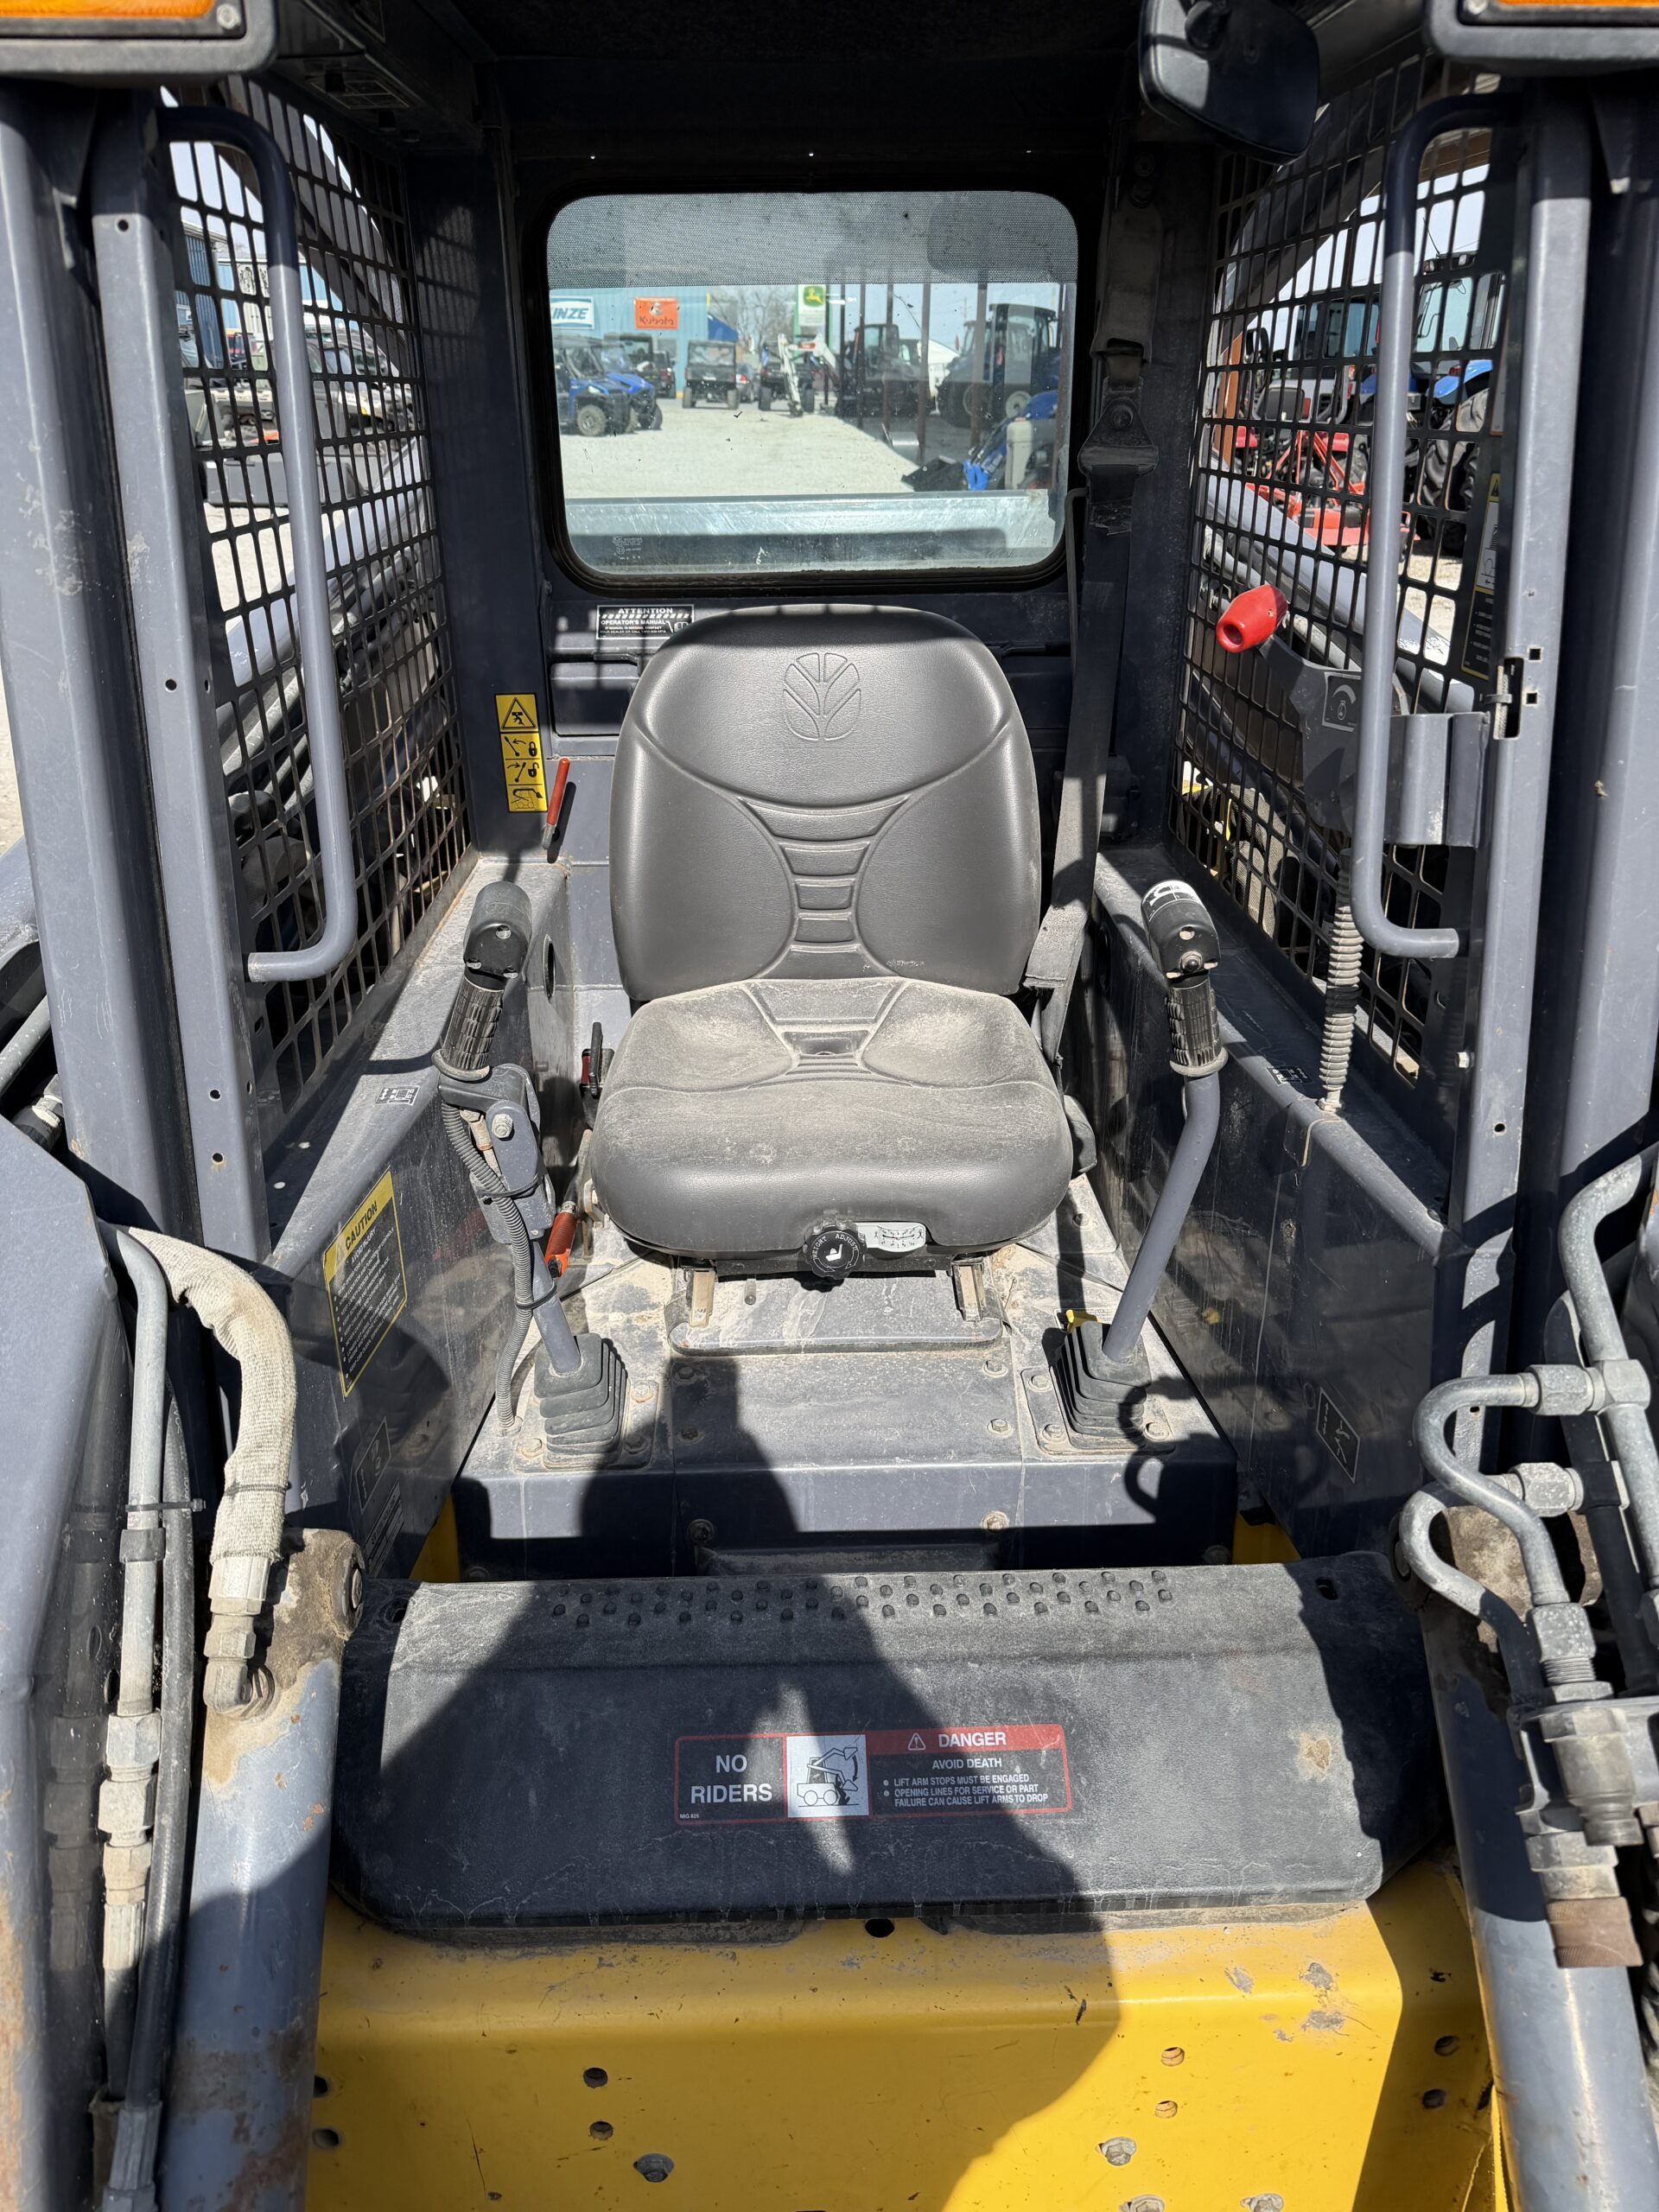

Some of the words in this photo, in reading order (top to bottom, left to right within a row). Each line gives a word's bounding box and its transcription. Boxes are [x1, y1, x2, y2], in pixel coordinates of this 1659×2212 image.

[639, 315, 674, 326] Kubota
[346, 1200, 378, 1250] CAUTION
[812, 1236, 827, 1259] WEIGHT
[835, 1234, 859, 1250] ADJUST
[938, 1732, 1007, 1748] DANGER
[715, 1754, 747, 1773] NO
[932, 1758, 964, 1770] AVOID
[966, 1758, 1002, 1768] DEATH
[893, 1777, 910, 1787] LIFT
[912, 1777, 929, 1786] ARM
[930, 1777, 956, 1785] STOPS
[957, 1776, 978, 1784] MUST
[980, 1775, 990, 1783] BE
[992, 1773, 1029, 1783] ENGAGED
[690, 1783, 772, 1804] RIDERS
[894, 1788, 929, 1797] OPENING
[931, 1787, 953, 1796] LINES
[955, 1786, 970, 1796] FOR
[972, 1785, 1004, 1795] SERVICE
[1007, 1784, 1018, 1794] OR
[1019, 1783, 1039, 1793] PART
[894, 1797, 927, 1807] FAILURE
[928, 1796, 944, 1806] CAN
[946, 1796, 973, 1805] CAUSE
[974, 1796, 989, 1804] LIFT
[991, 1795, 1014, 1803] ARMS
[1014, 1795, 1025, 1803] TO
[1026, 1793, 1048, 1802] DROP
